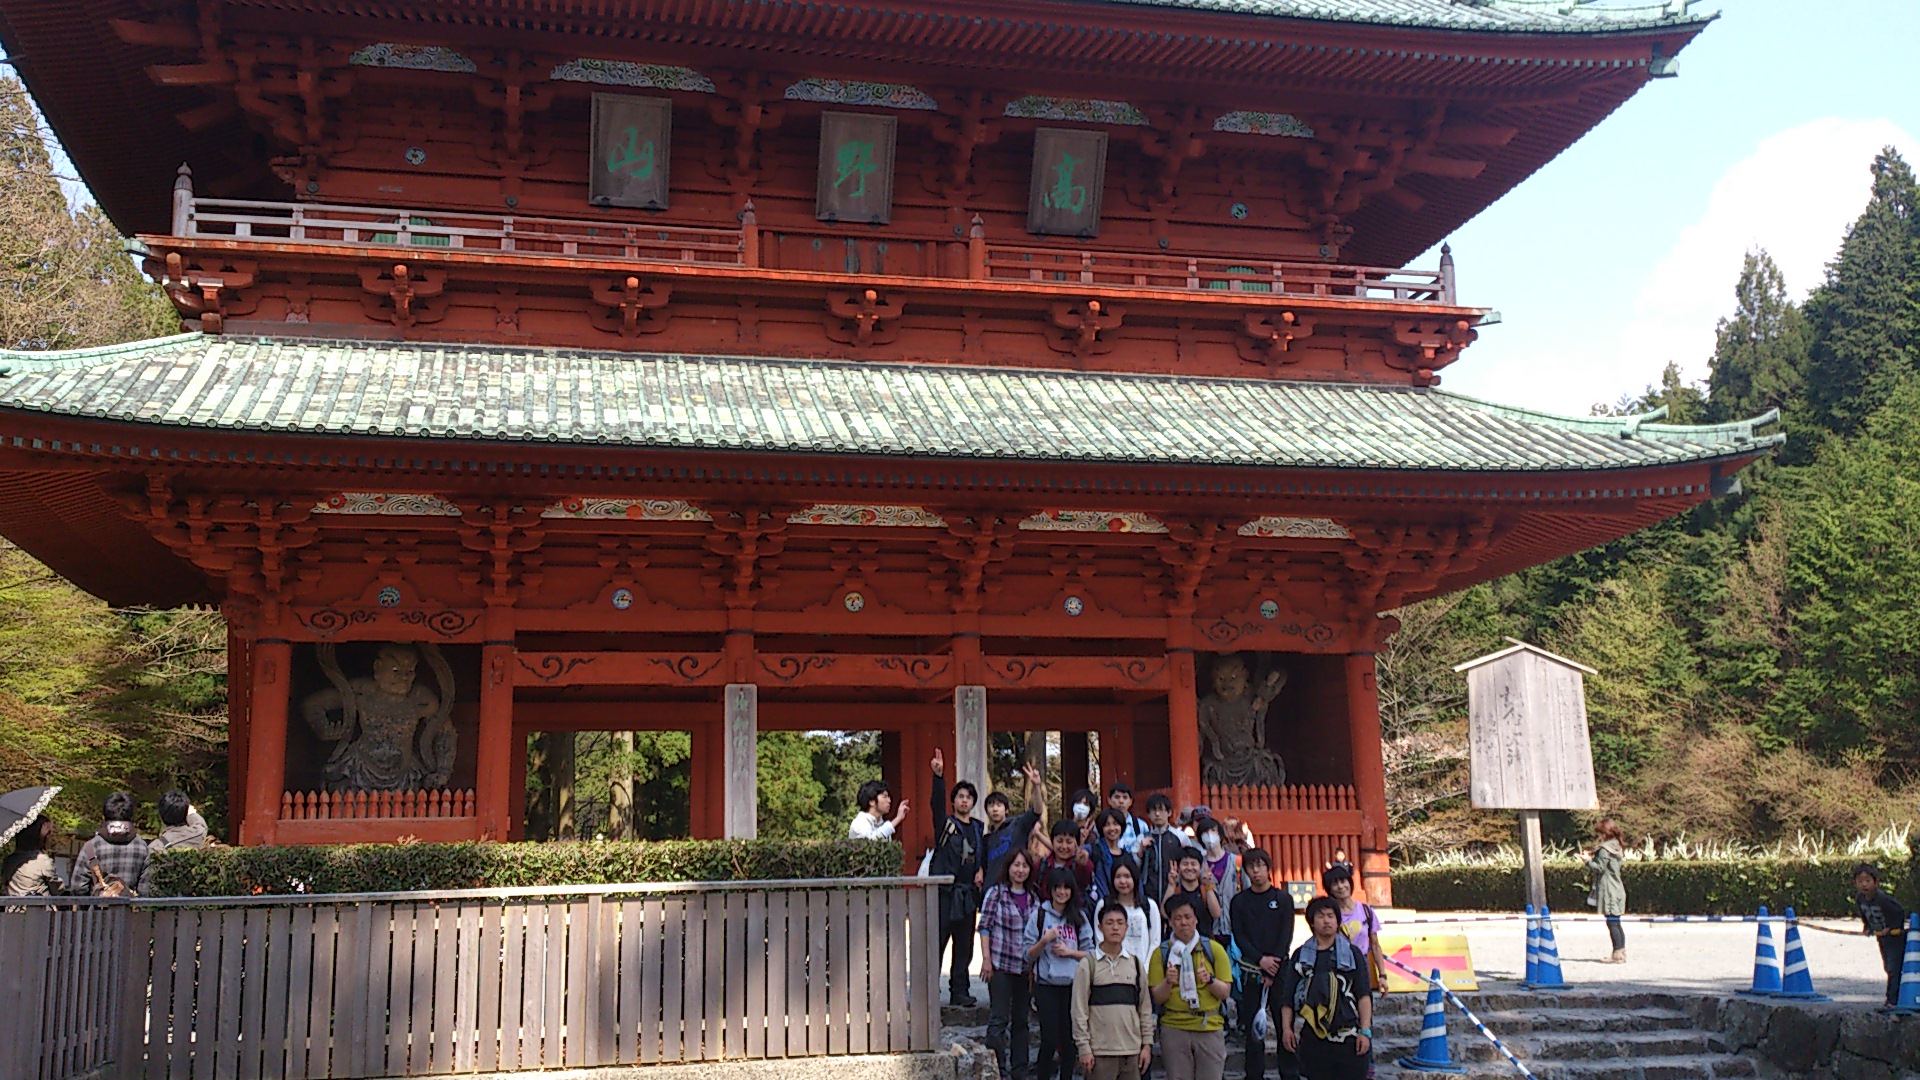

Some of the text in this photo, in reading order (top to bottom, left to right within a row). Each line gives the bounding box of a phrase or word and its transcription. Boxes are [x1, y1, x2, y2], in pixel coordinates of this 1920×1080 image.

[608, 127, 654, 179] 山
[834, 140, 877, 197] 野
[1044, 151, 1086, 214] 高
